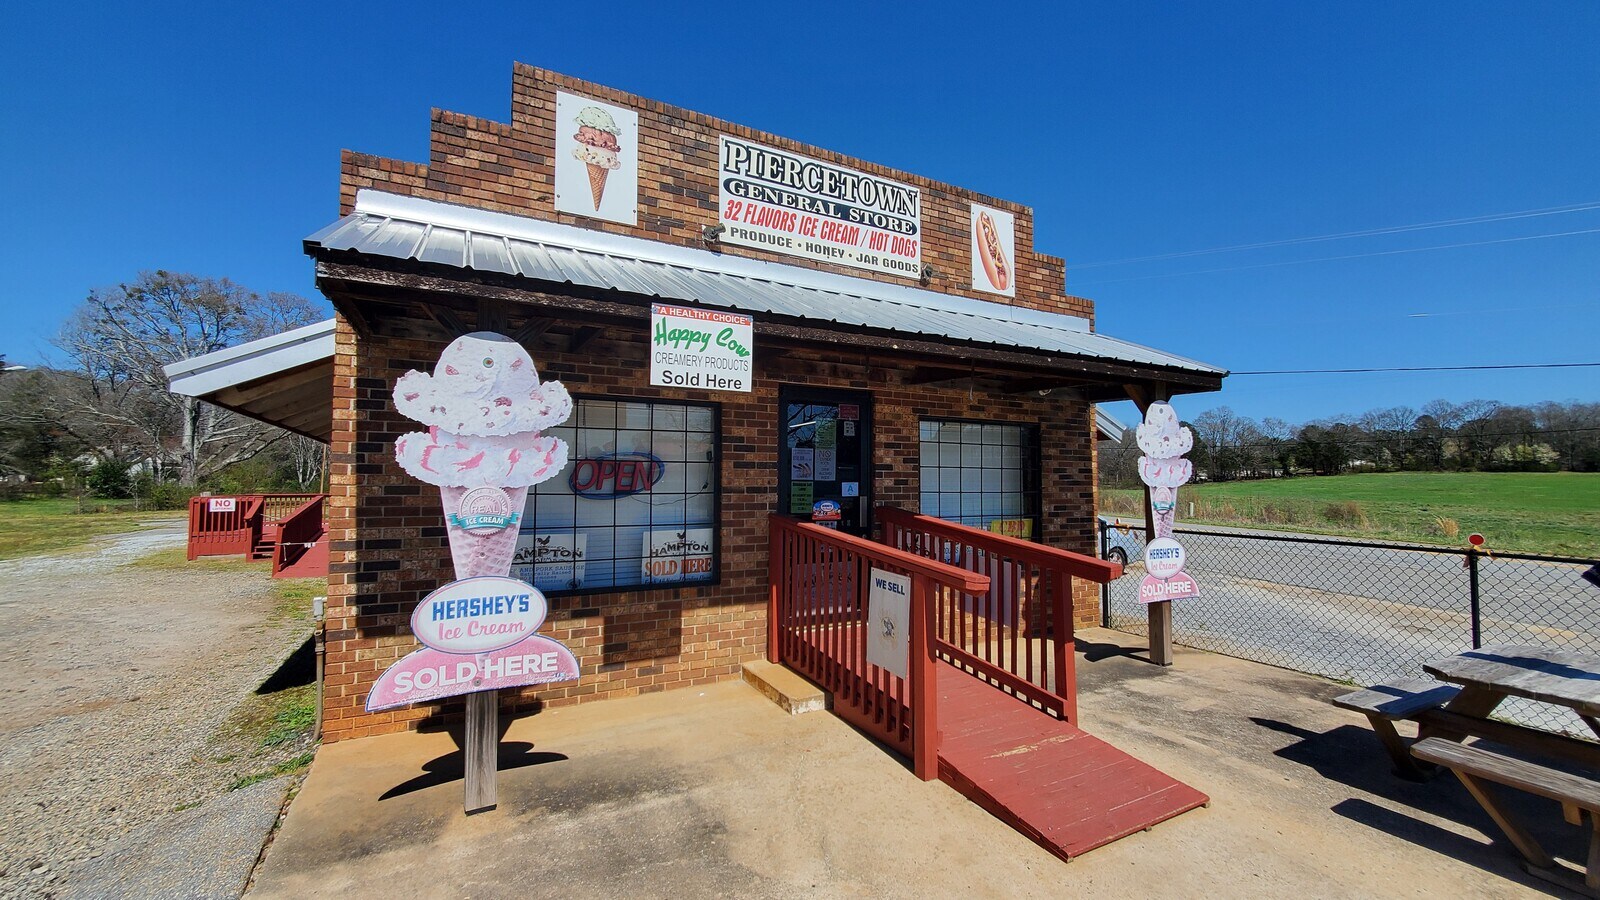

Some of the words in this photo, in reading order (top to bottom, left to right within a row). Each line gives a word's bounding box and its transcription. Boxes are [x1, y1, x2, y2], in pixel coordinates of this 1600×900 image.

[724, 140, 920, 218] PIERCETOWN
[729, 181, 841, 218] GENERAL
[849, 208, 914, 235] STORE
[724, 199, 742, 221] 32
[743, 204, 798, 233] FLAVORS
[798, 216, 817, 238] ICE
[820, 220, 860, 247] CREAM
[869, 230, 892, 252] HOT
[893, 235, 918, 259] DOGS
[730, 227, 793, 249] PRODUCE
[806, 242, 845, 259] HONEY
[856, 252, 879, 266] JAR
[882, 258, 919, 273] GOODS
[669, 308, 712, 320] HEALTHY
[654, 316, 713, 353] Happy
[715, 327, 751, 358] Cow
[655, 351, 703, 368] CREAMERY
[705, 356, 749, 372] PRODUCTS
[661, 370, 700, 387] Sold
[706, 373, 742, 390] Here
[573, 459, 657, 492] OPEN
[470, 504, 500, 514] REAL
[466, 517, 478, 525] ICE
[479, 516, 504, 525] CREAM
[514, 548, 582, 561] AMPTON
[651, 543, 708, 556] HAMPTON
[1149, 548, 1180, 559] HERSHEY'S
[644, 559, 678, 577] SOLD
[681, 558, 711, 574] HERE
[1158, 560, 1178, 570] Cream
[875, 577, 887, 590] WE
[887, 581, 905, 596] SELL
[1142, 583, 1163, 597] SOLD
[1165, 581, 1191, 594] HERE
[432, 592, 530, 622] HERSHEY'S
[438, 622, 463, 641] Ice
[467, 620, 527, 638] Cream
[393, 662, 478, 694] SOLD
[485, 651, 559, 680] HERE
